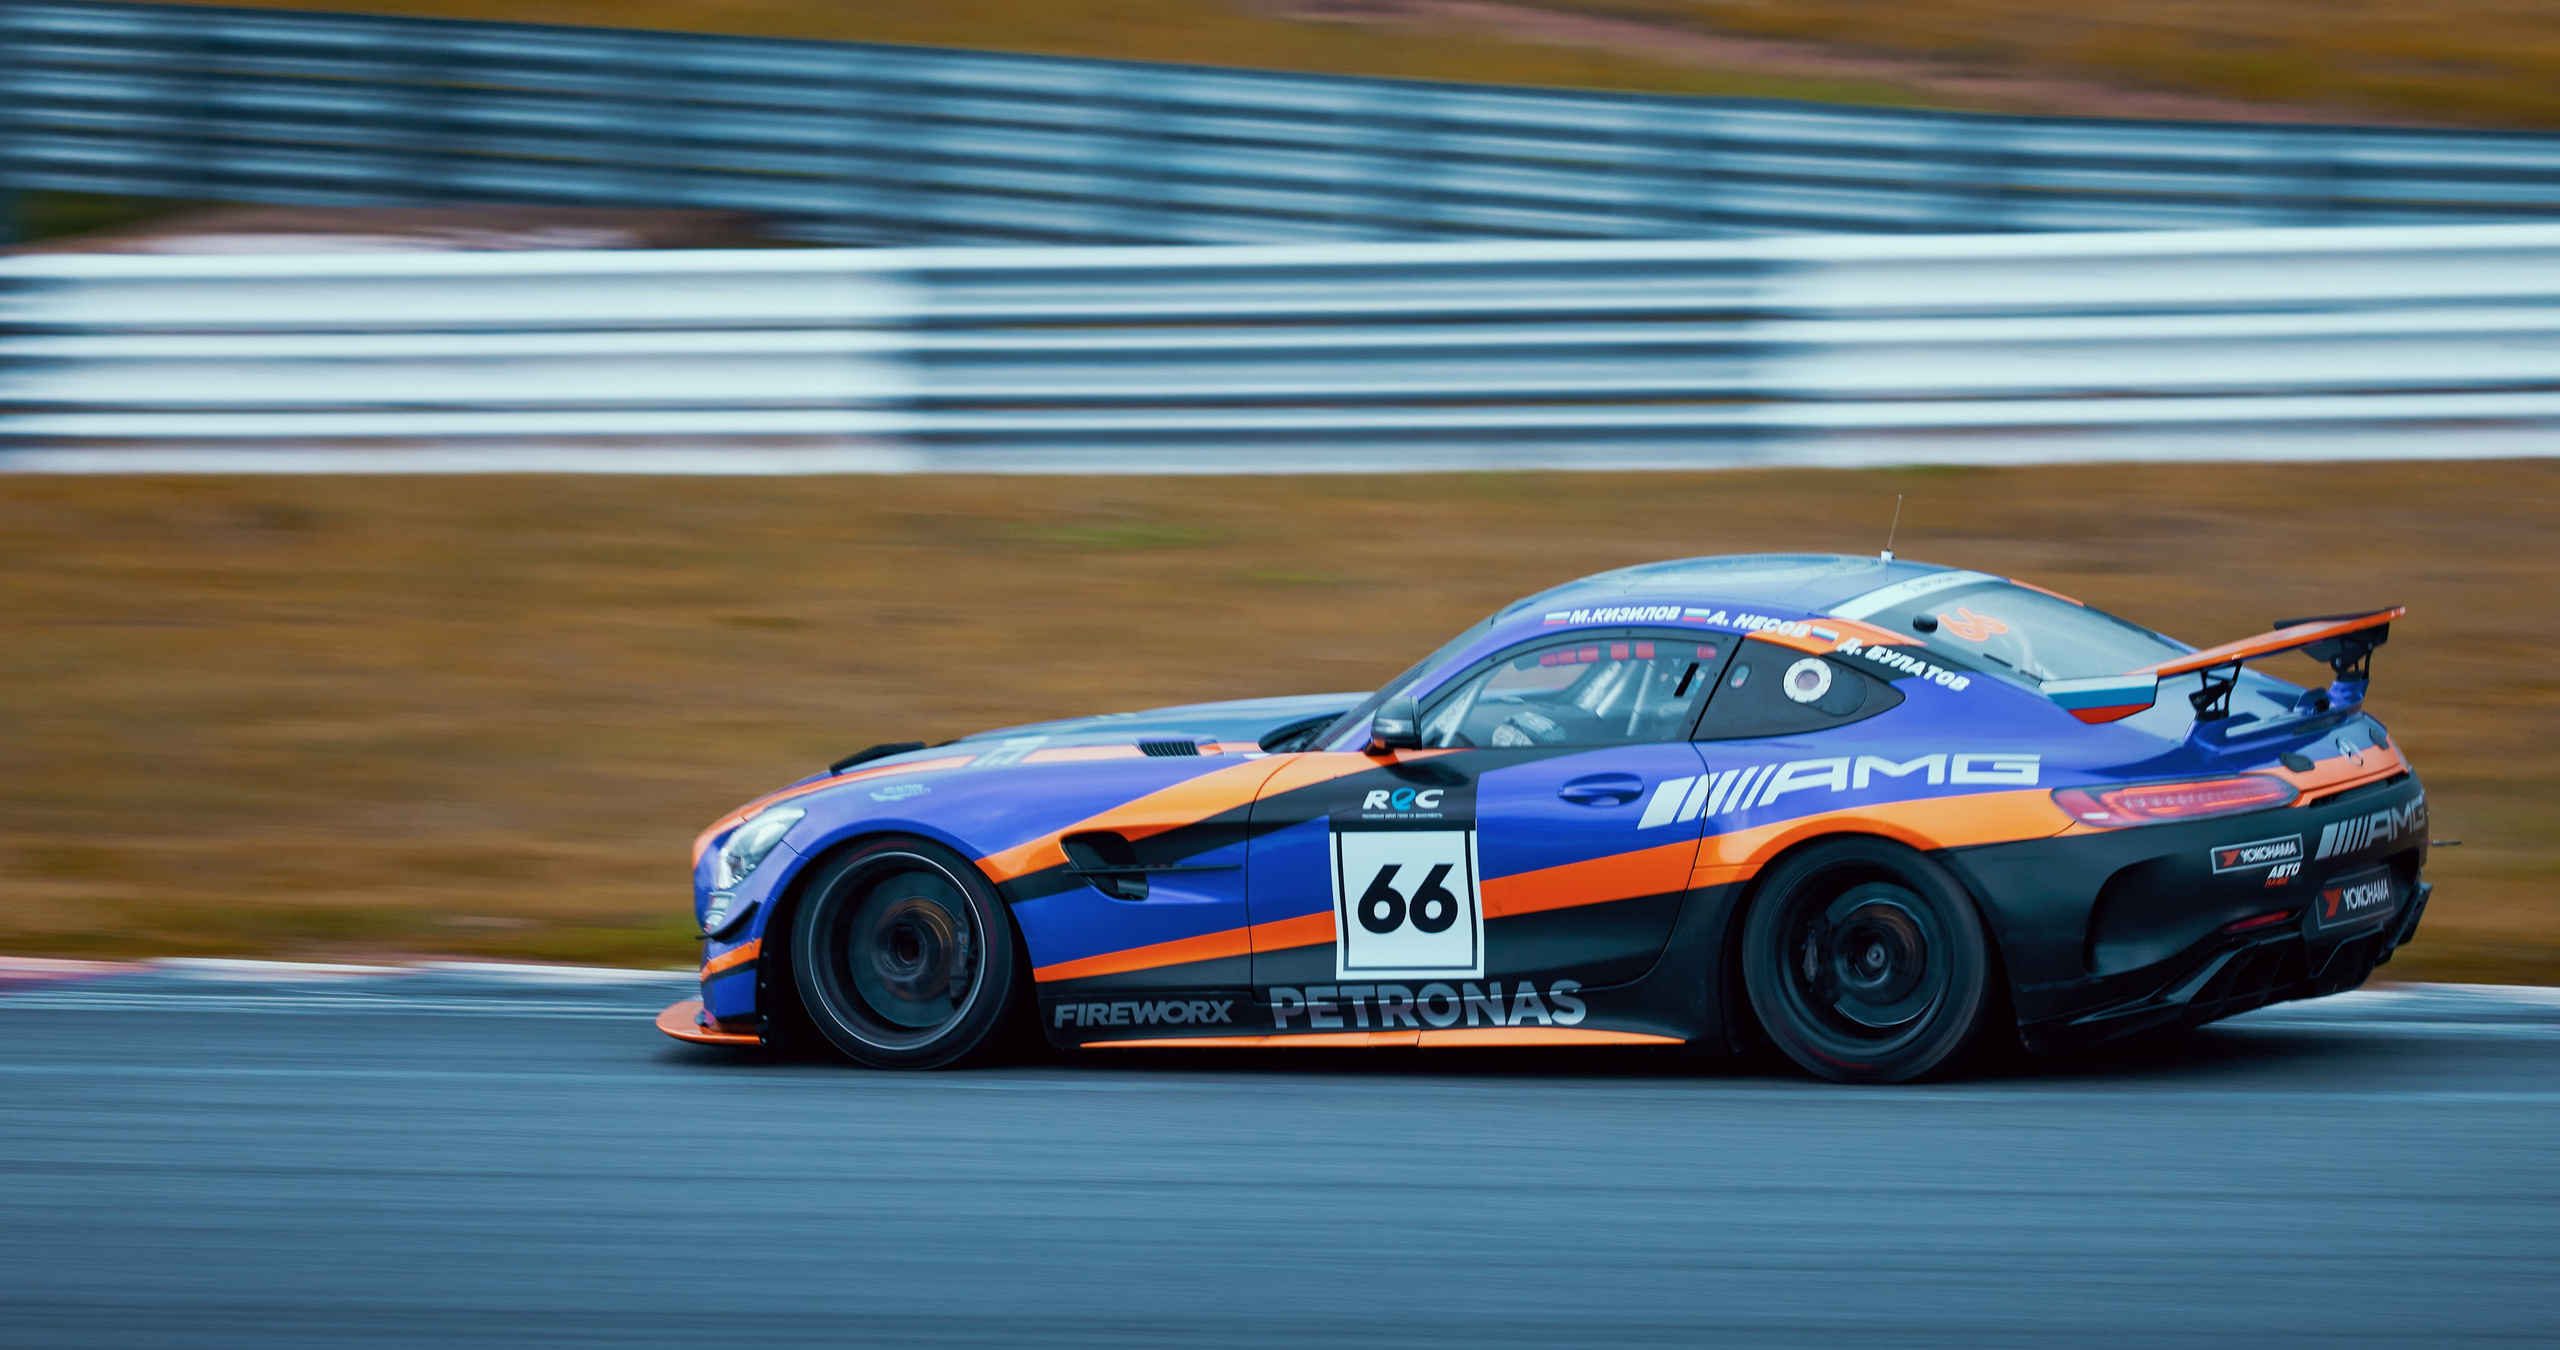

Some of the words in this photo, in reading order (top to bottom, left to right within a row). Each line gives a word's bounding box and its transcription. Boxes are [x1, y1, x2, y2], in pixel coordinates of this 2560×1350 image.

[1732, 613, 1812, 639] НЕСОВ
[1864, 645, 1971, 693] БУЛАТОВ
[2240, 841, 2297, 864] YOKOHAMA
[2267, 862, 2302, 880] АВТО
[1357, 863, 1459, 934] 66
[2342, 879, 2390, 911] YOKOHAMA
[1053, 1000, 1234, 1028] FIREWORX
[1268, 980, 1587, 1029] PETRONAS
